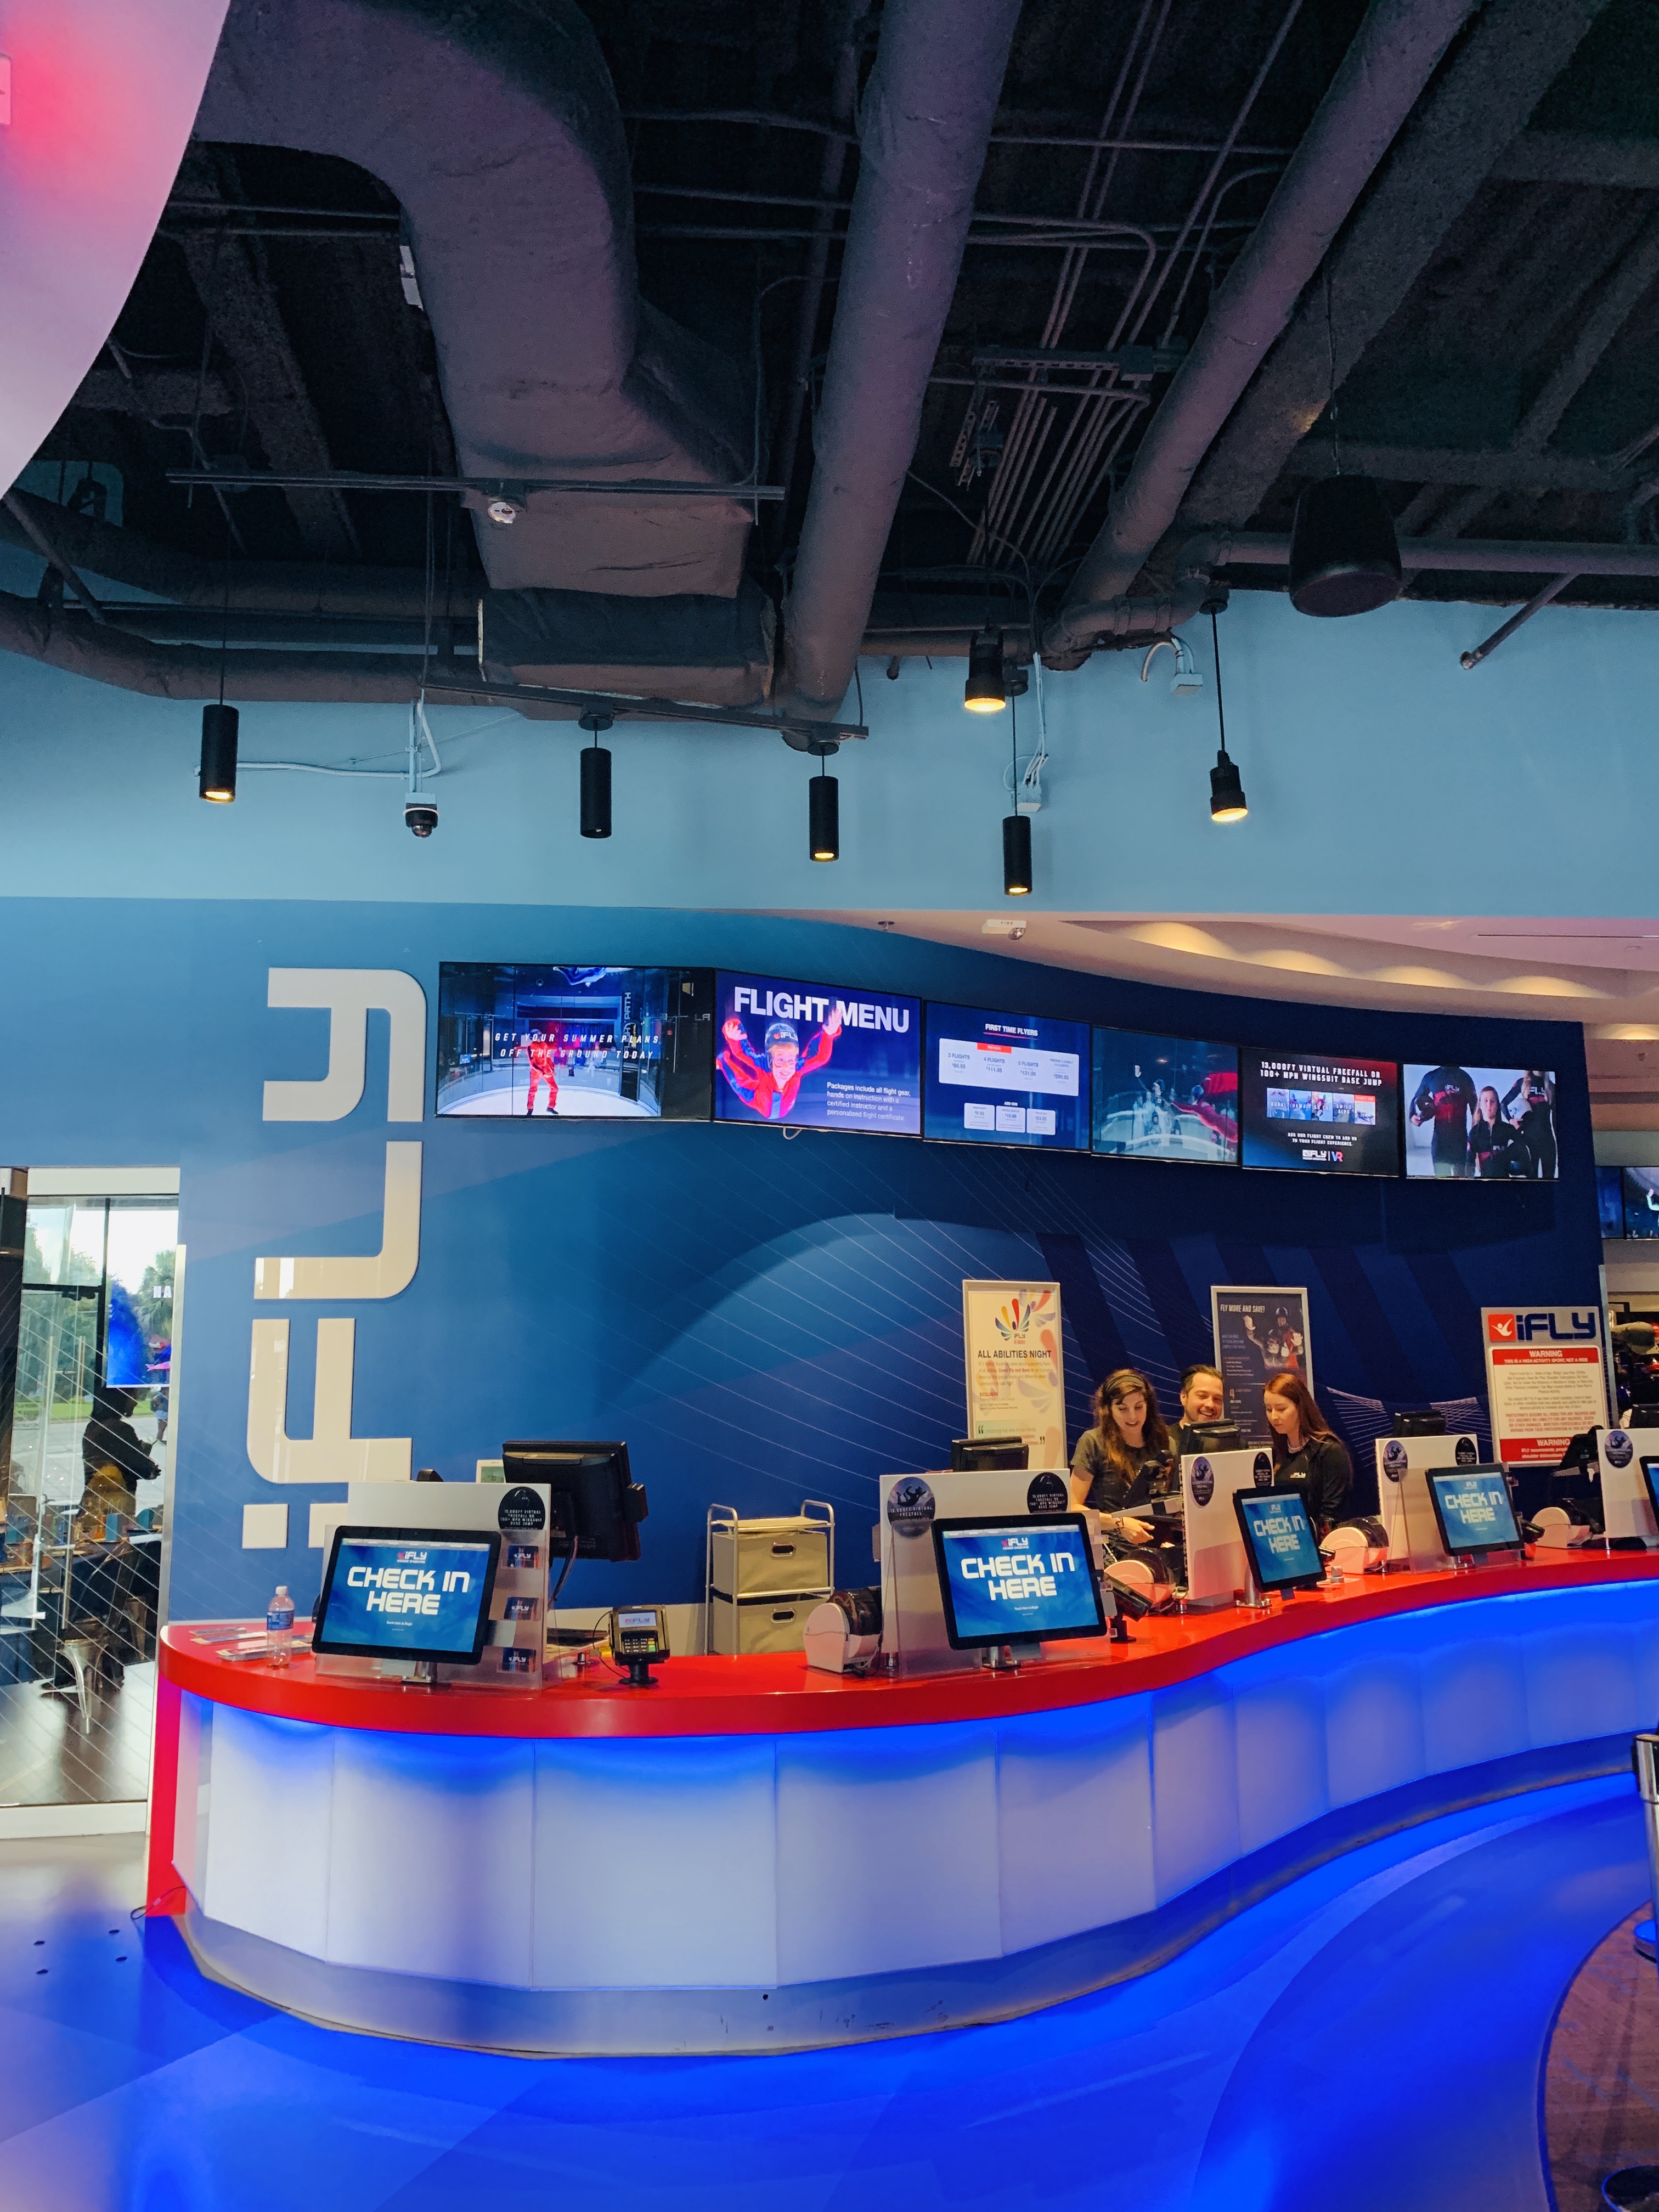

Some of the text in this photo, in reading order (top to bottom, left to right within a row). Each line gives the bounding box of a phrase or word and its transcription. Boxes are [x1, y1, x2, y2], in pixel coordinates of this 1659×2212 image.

[735, 986, 909, 1033] FLIGHT MENU
[985, 1023, 1038, 1036] FIRST TIME FLYERS
[495, 1033, 659, 1043] GET YOUR SUMMER PLANS
[500, 1049, 522, 1057] OFF
[531, 1049, 551, 1057] THE
[616, 1051, 653, 1059] TODAY
[1261, 1061, 1296, 1071] 13,000FT
[1299, 1064, 1330, 1074] VIRTUAL
[1333, 1068, 1368, 1077] FREEFALL
[1260, 1069, 1279, 1077] 100+
[1302, 1073, 1339, 1082] WINGSUIT
[1342, 1076, 1359, 1085] BASE
[1363, 1078, 1382, 1086] JUMP
[827, 1082, 854, 1091] Packages
[855, 1085, 875, 1093] include
[854, 1093, 882, 1102] instruction
[827, 1109, 862, 1118] personalized
[851, 1102, 876, 1110] instructor
[1331, 1151, 1344, 1162] VR
[1516, 1312, 1596, 1340] iFLY
[1537, 1438, 1570, 1447] WARNING
[1444, 1491, 1503, 1509] CHECK IN
[1460, 1507, 1496, 1524] HERE
[1253, 1515, 1305, 1537] CHECK IN
[1007, 1537, 1029, 1547] iFLY
[1268, 1534, 1301, 1554] HERE
[405, 1551, 427, 1560] iFLY
[961, 1552, 1075, 1579] CHECK IN
[347, 1566, 470, 1593] CHECK IN
[988, 1576, 1057, 1601] HERE
[366, 1590, 441, 1615] HERE
